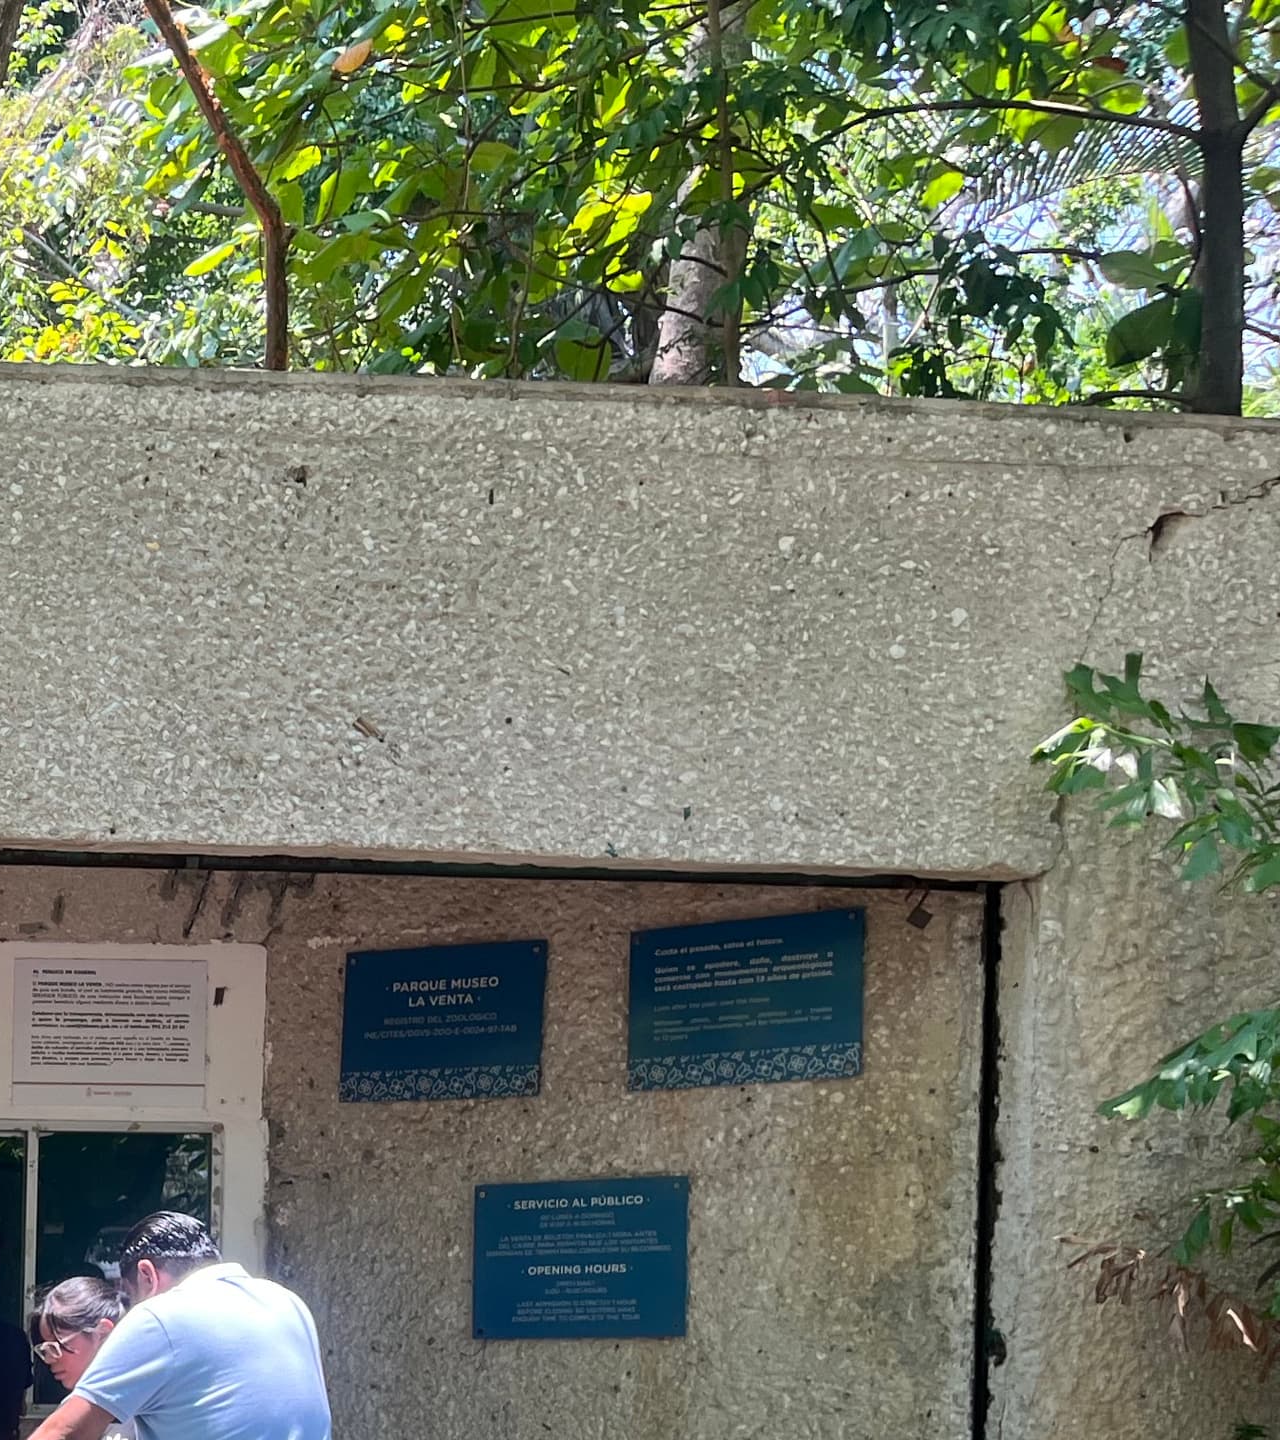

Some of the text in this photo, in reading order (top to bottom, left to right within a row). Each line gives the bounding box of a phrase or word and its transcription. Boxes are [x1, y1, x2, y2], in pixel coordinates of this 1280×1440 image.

[392, 976, 499, 993] PARQUE MUSEO
[408, 994, 474, 1008] LA VENTA
[514, 1195, 644, 1210] SERVICIO AL PÚBLICO
[528, 1264, 626, 1276] OPENING HOURS
